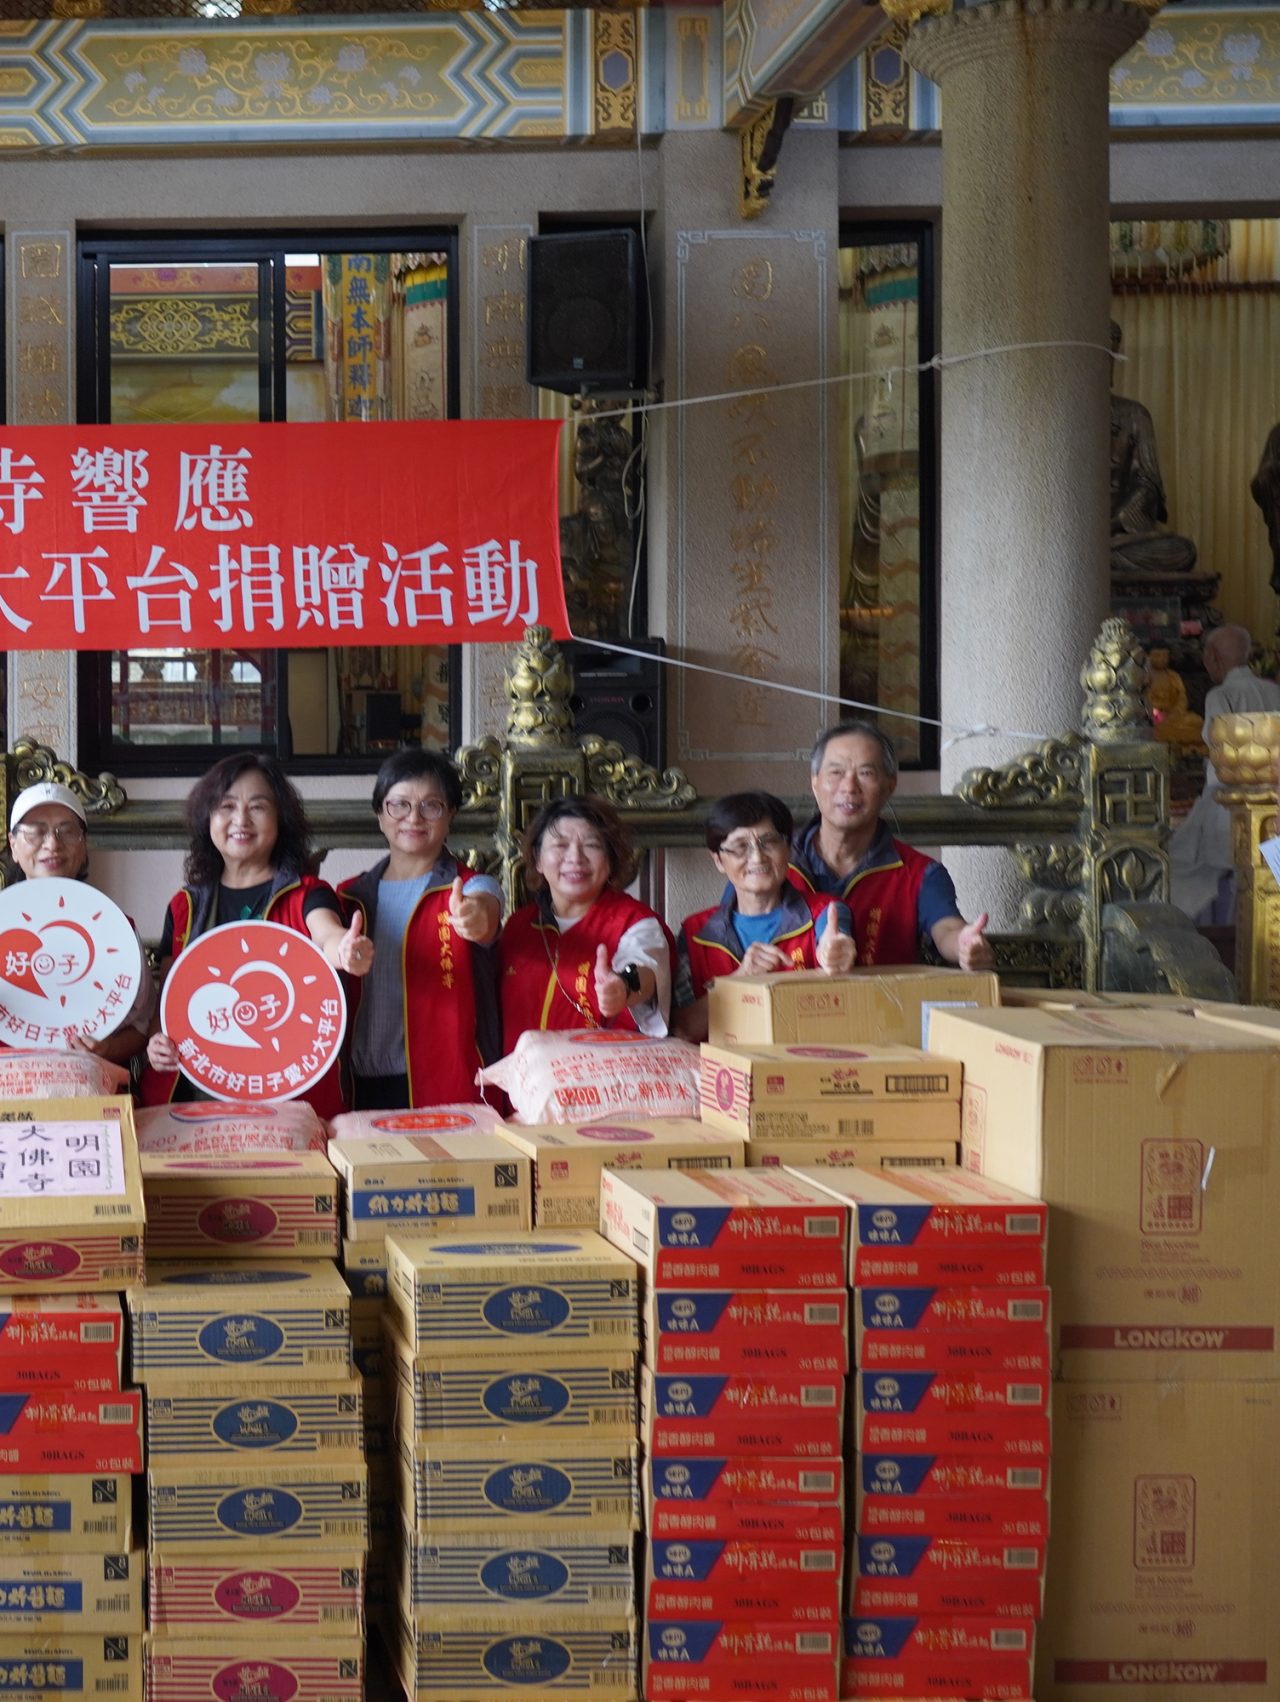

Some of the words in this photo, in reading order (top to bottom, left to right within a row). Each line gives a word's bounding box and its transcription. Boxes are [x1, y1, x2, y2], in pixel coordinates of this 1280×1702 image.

[177, 998, 340, 1095] 新北市好日子愛心大平台
[17, 1125, 55, 1193] 大佛寺
[65, 1134, 101, 1179] 明園
[1114, 1328, 1225, 1348] LONGKOW
[1107, 1663, 1220, 1682] LONGKOW
